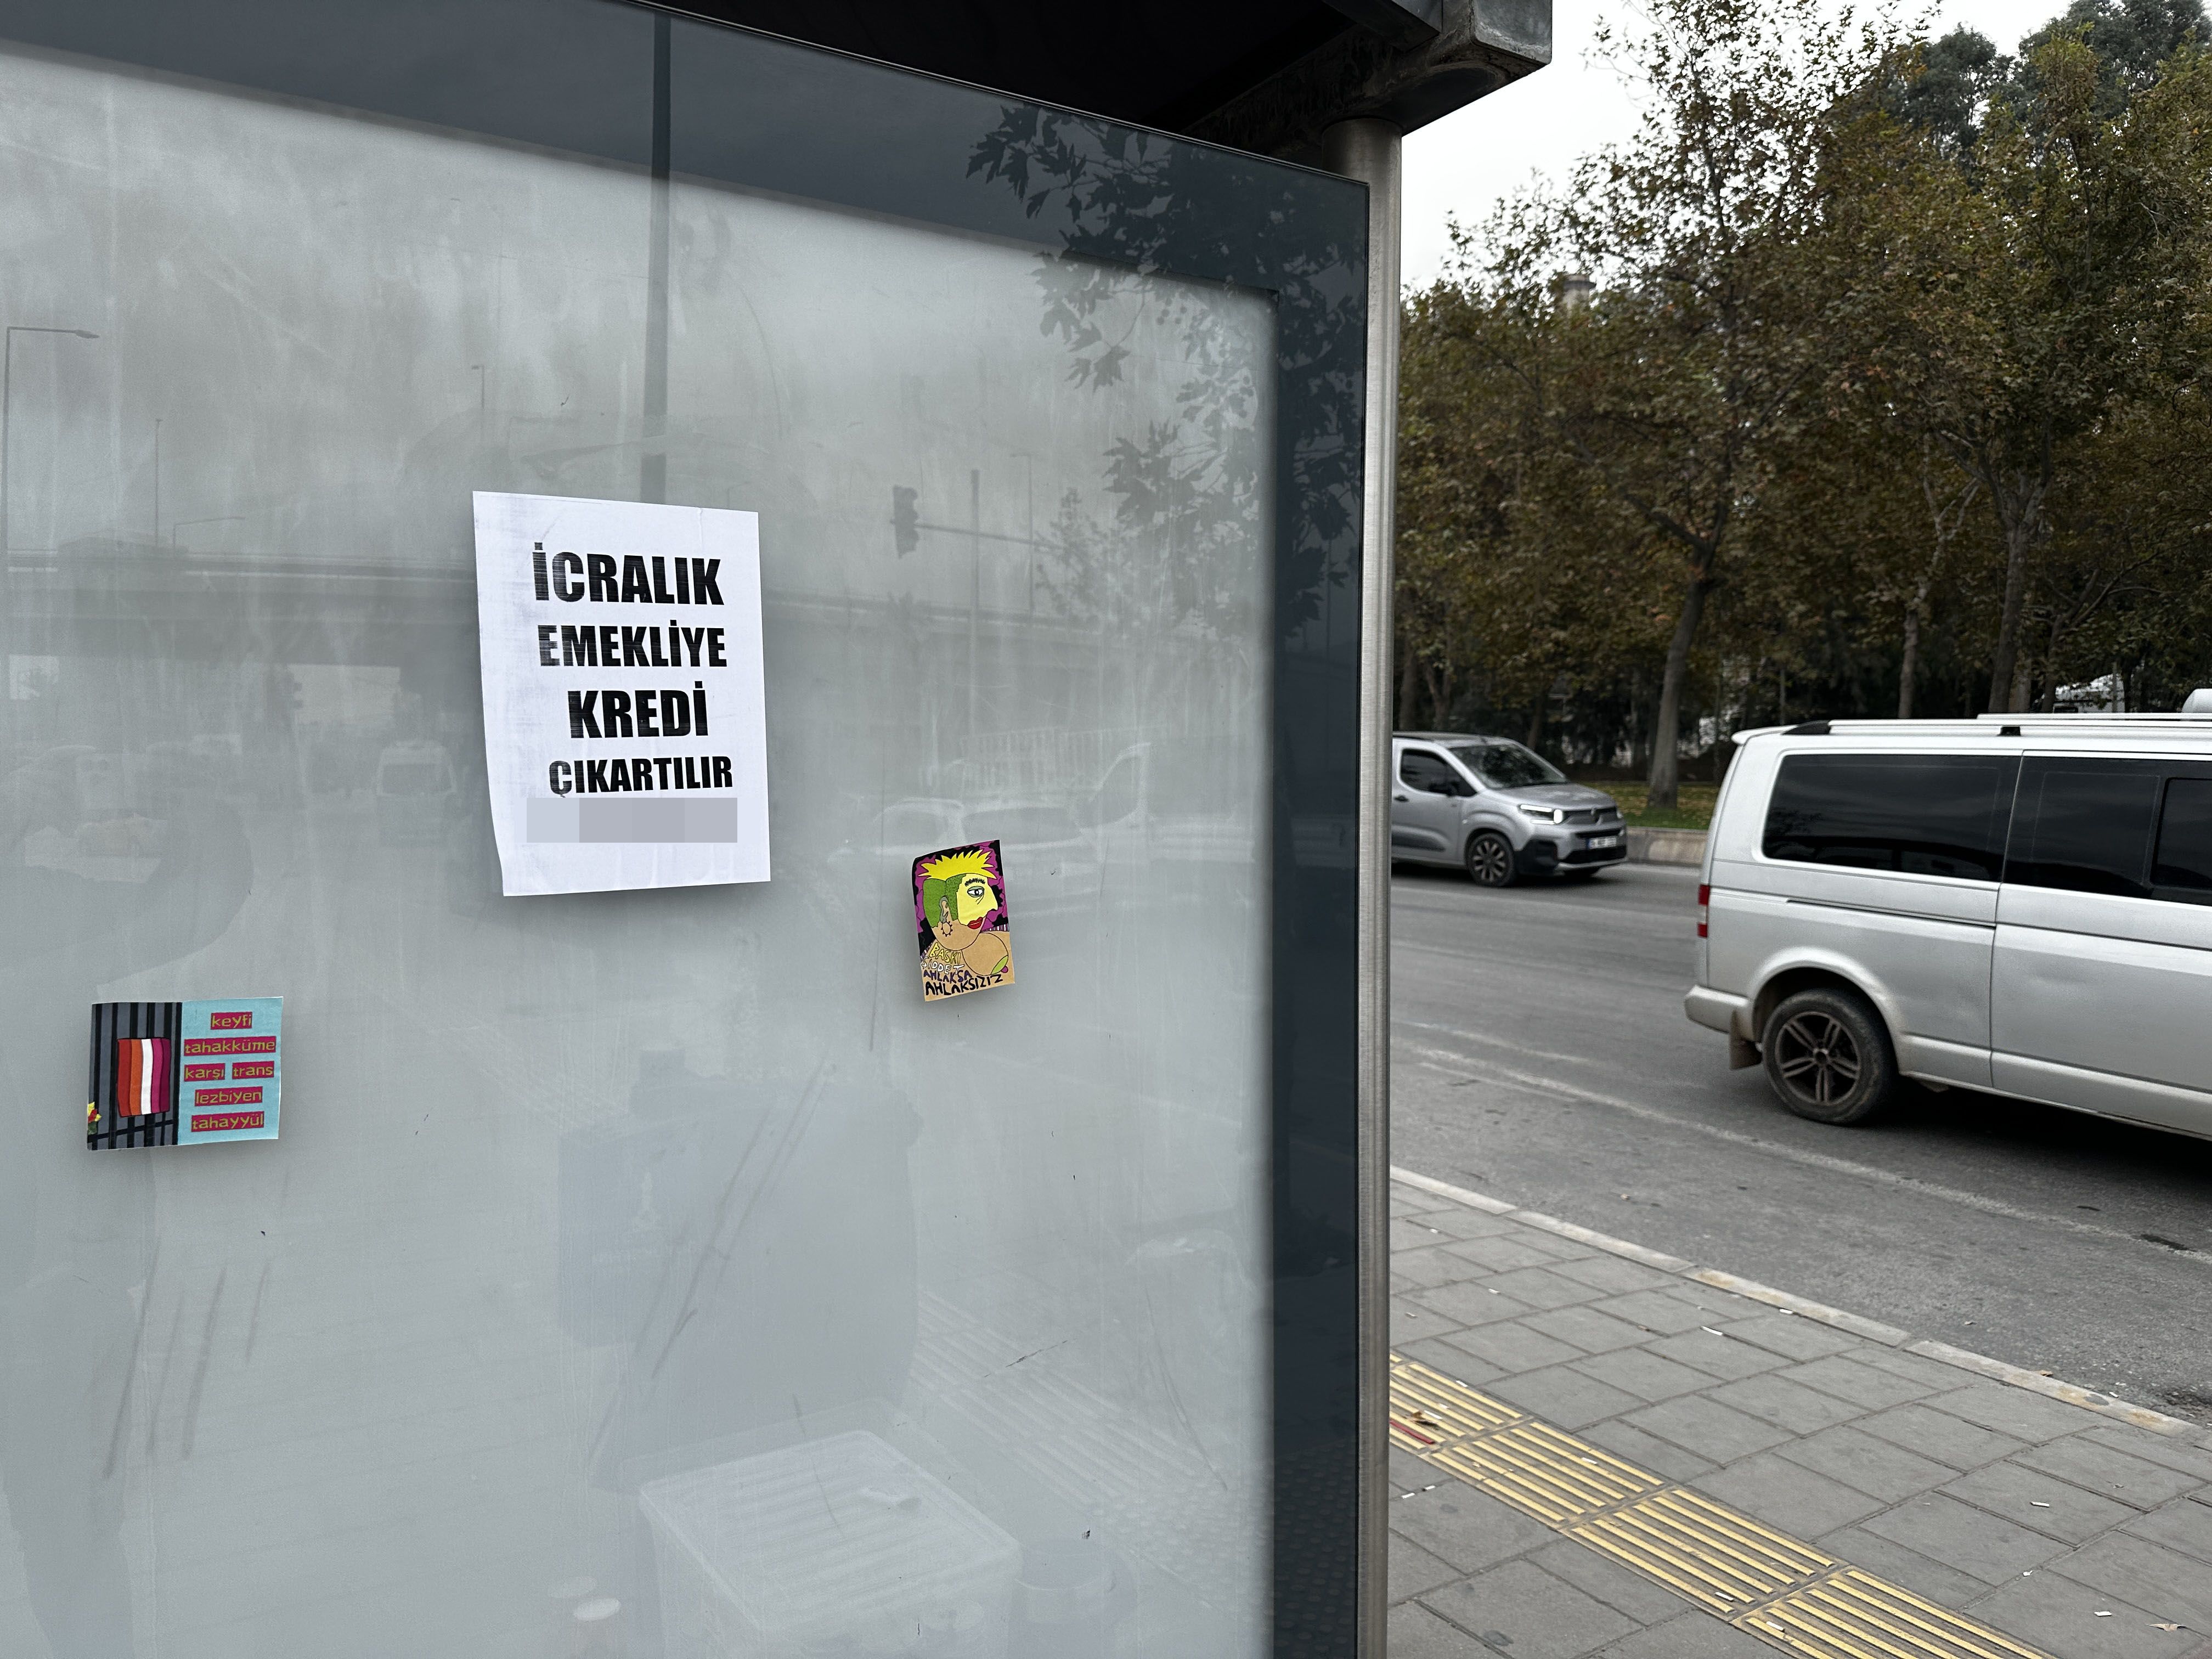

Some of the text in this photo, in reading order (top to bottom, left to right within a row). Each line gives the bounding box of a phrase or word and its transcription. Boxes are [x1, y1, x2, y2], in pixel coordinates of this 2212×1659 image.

[532, 541, 724, 605] İCRALIK
[538, 619, 727, 667] EMEKLİYE
[567, 681, 709, 738] KREDİ
[549, 756, 733, 798] ÇIKARTILIR
[929, 942, 961, 964] BASKI
[924, 970, 972, 984] AHLAKSA
[926, 974, 1003, 996] AHLAKSIZIZ
[211, 1014, 252, 1029] keyfi
[185, 1039, 275, 1054] tahakküme
[185, 1065, 274, 1080] karşı trans
[195, 1090, 262, 1104] lezbiyen
[193, 1113, 264, 1130] tahayyül
